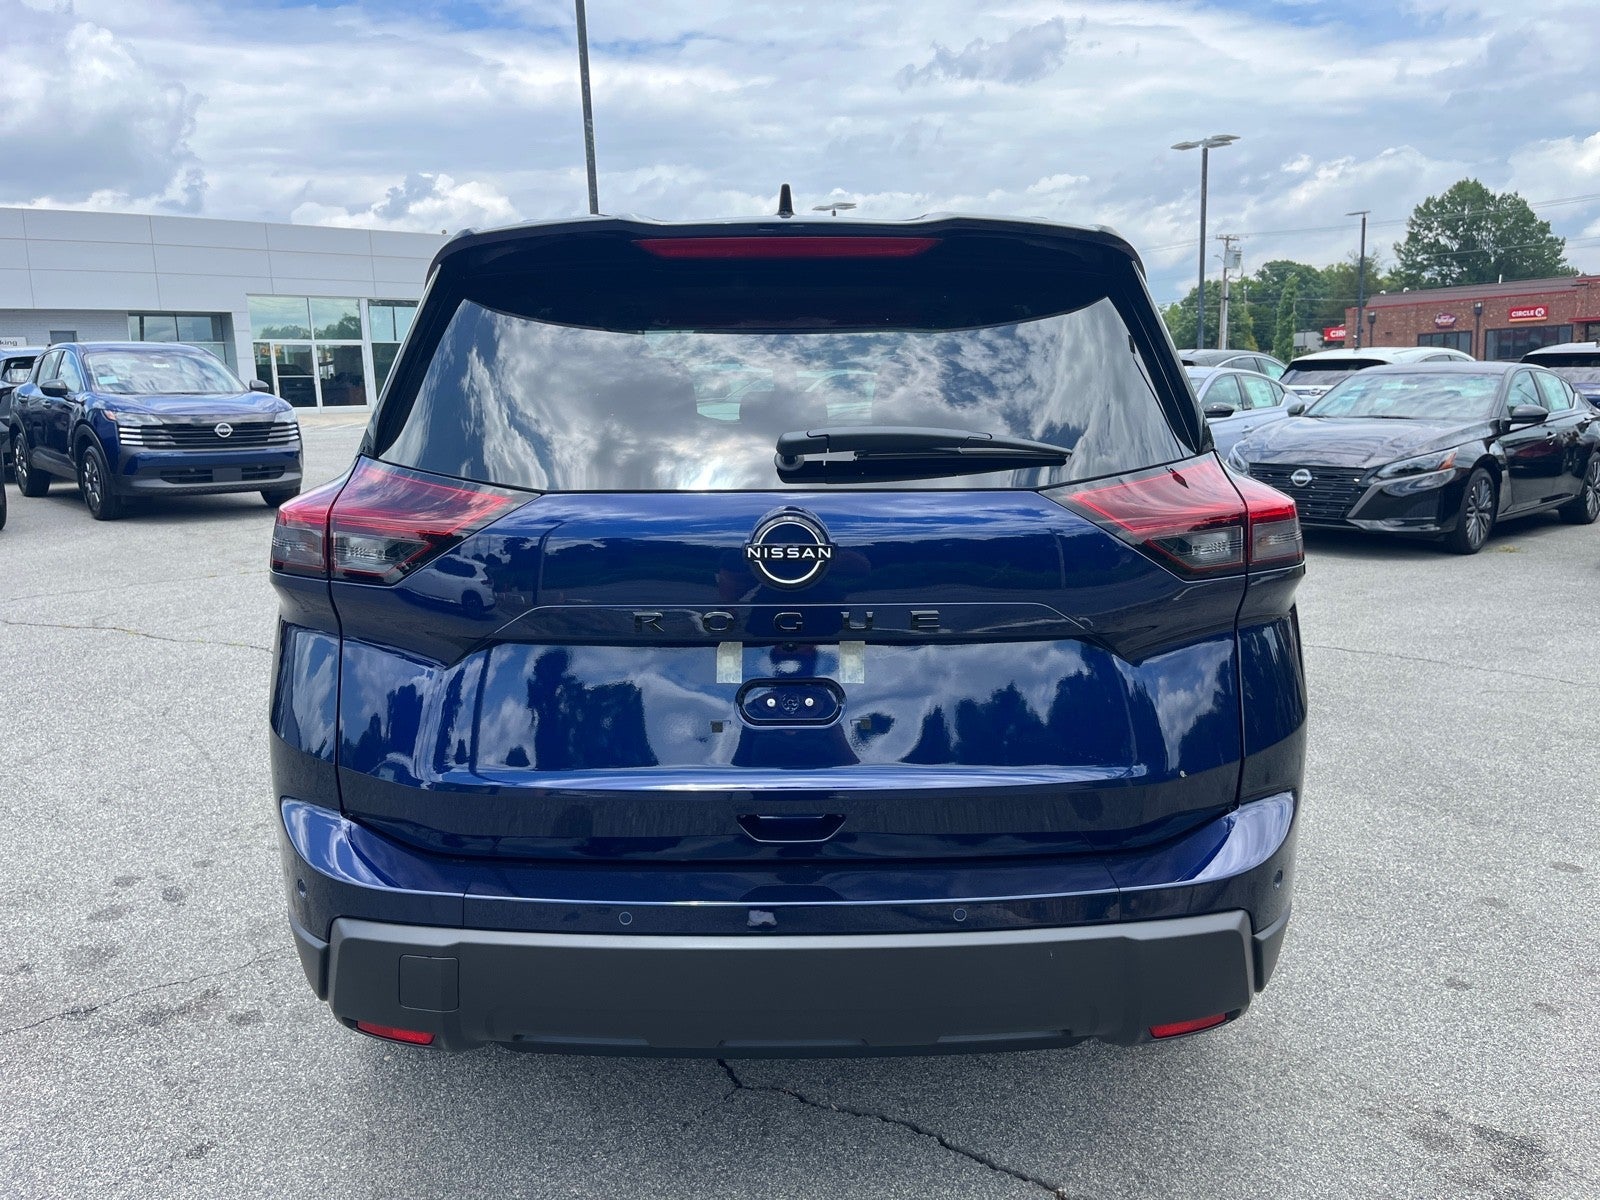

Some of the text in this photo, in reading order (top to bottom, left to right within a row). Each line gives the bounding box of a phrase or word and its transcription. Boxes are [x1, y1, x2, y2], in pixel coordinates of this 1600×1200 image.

[1511, 307, 1545, 318] CIRCLE K
[1329, 329, 1346, 338] CIR
[747, 547, 831, 559] NISSAN
[633, 610, 940, 632] ROGUE
